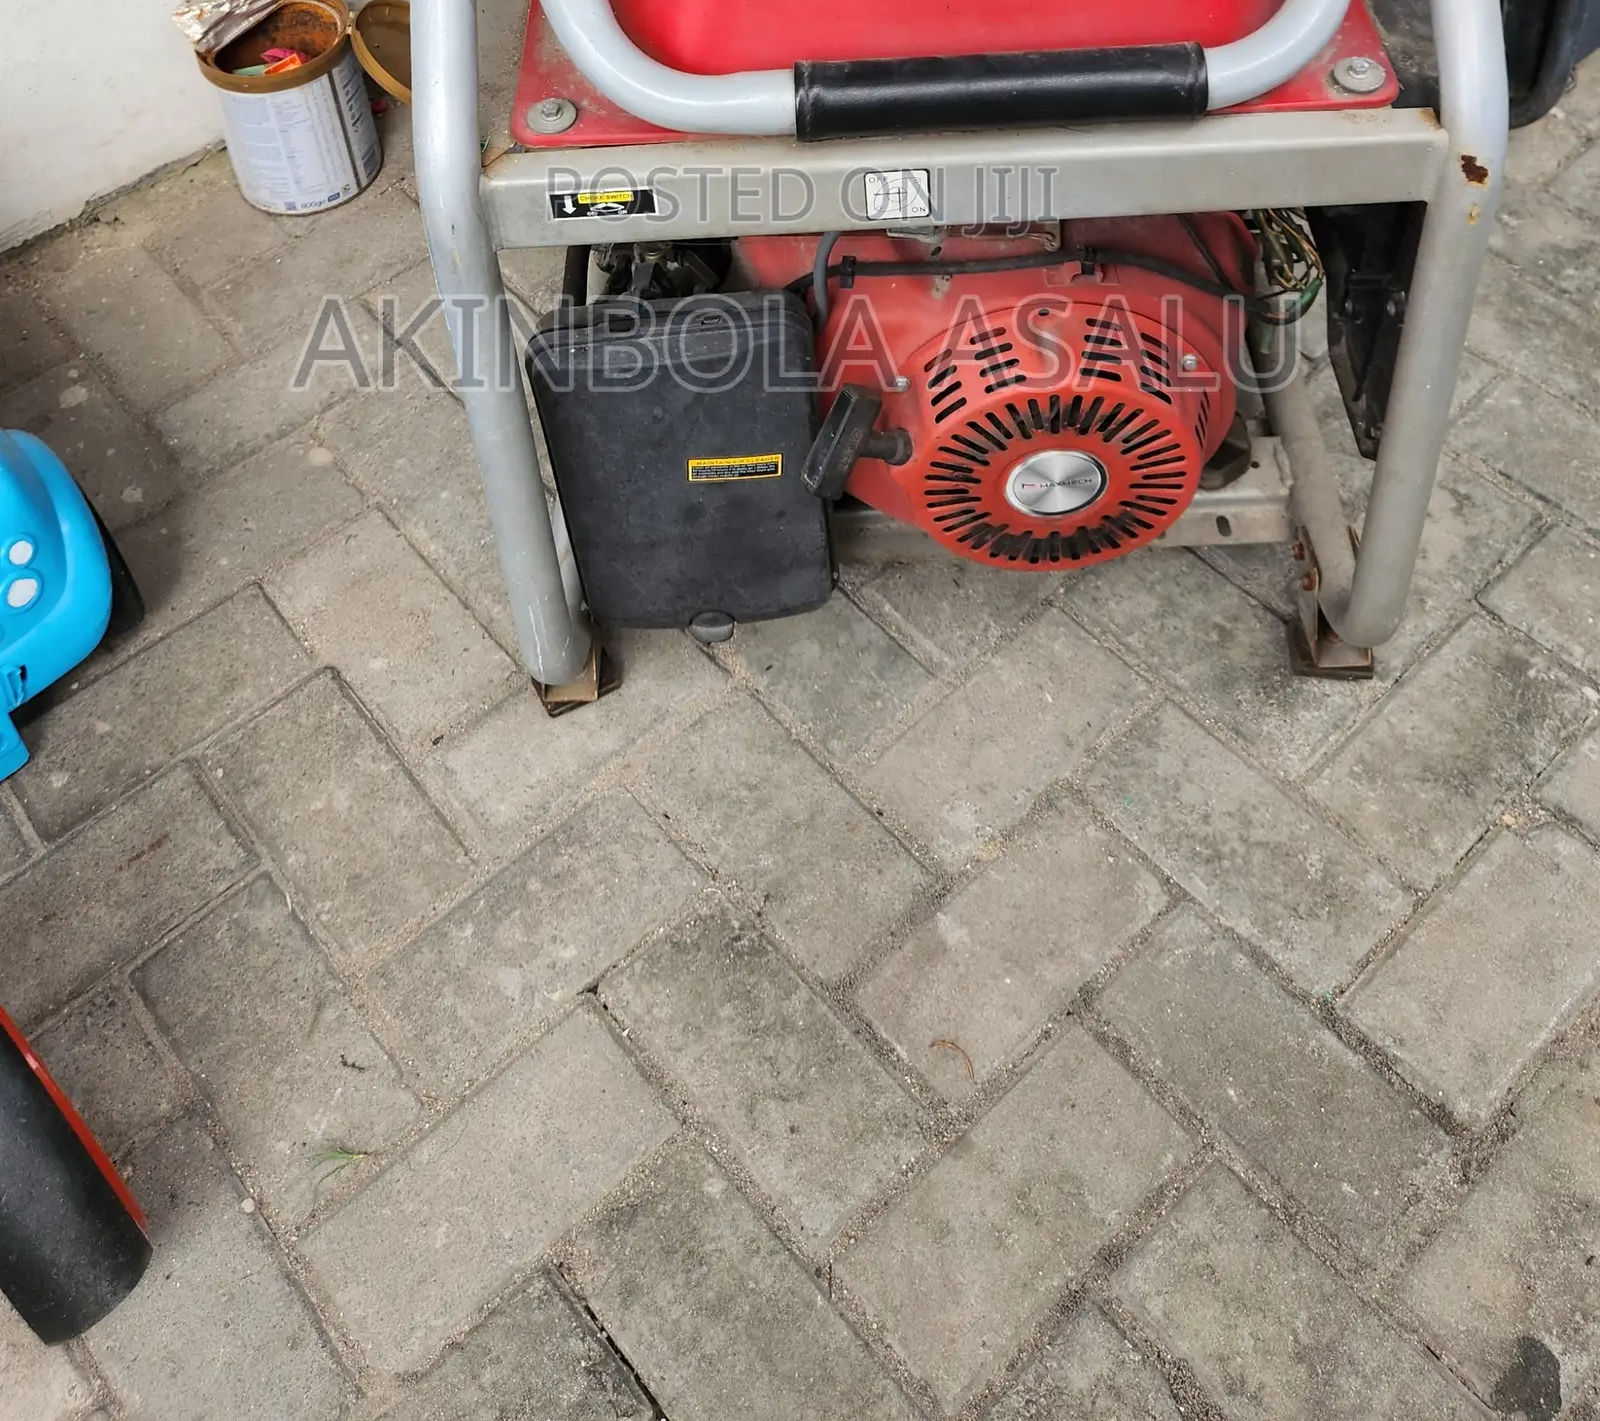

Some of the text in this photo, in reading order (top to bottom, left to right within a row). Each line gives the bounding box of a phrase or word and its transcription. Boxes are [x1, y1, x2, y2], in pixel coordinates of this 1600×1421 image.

[579, 193, 633, 202] CHOKE SWITCH
[1040, 478, 1092, 488] MAXMECH
